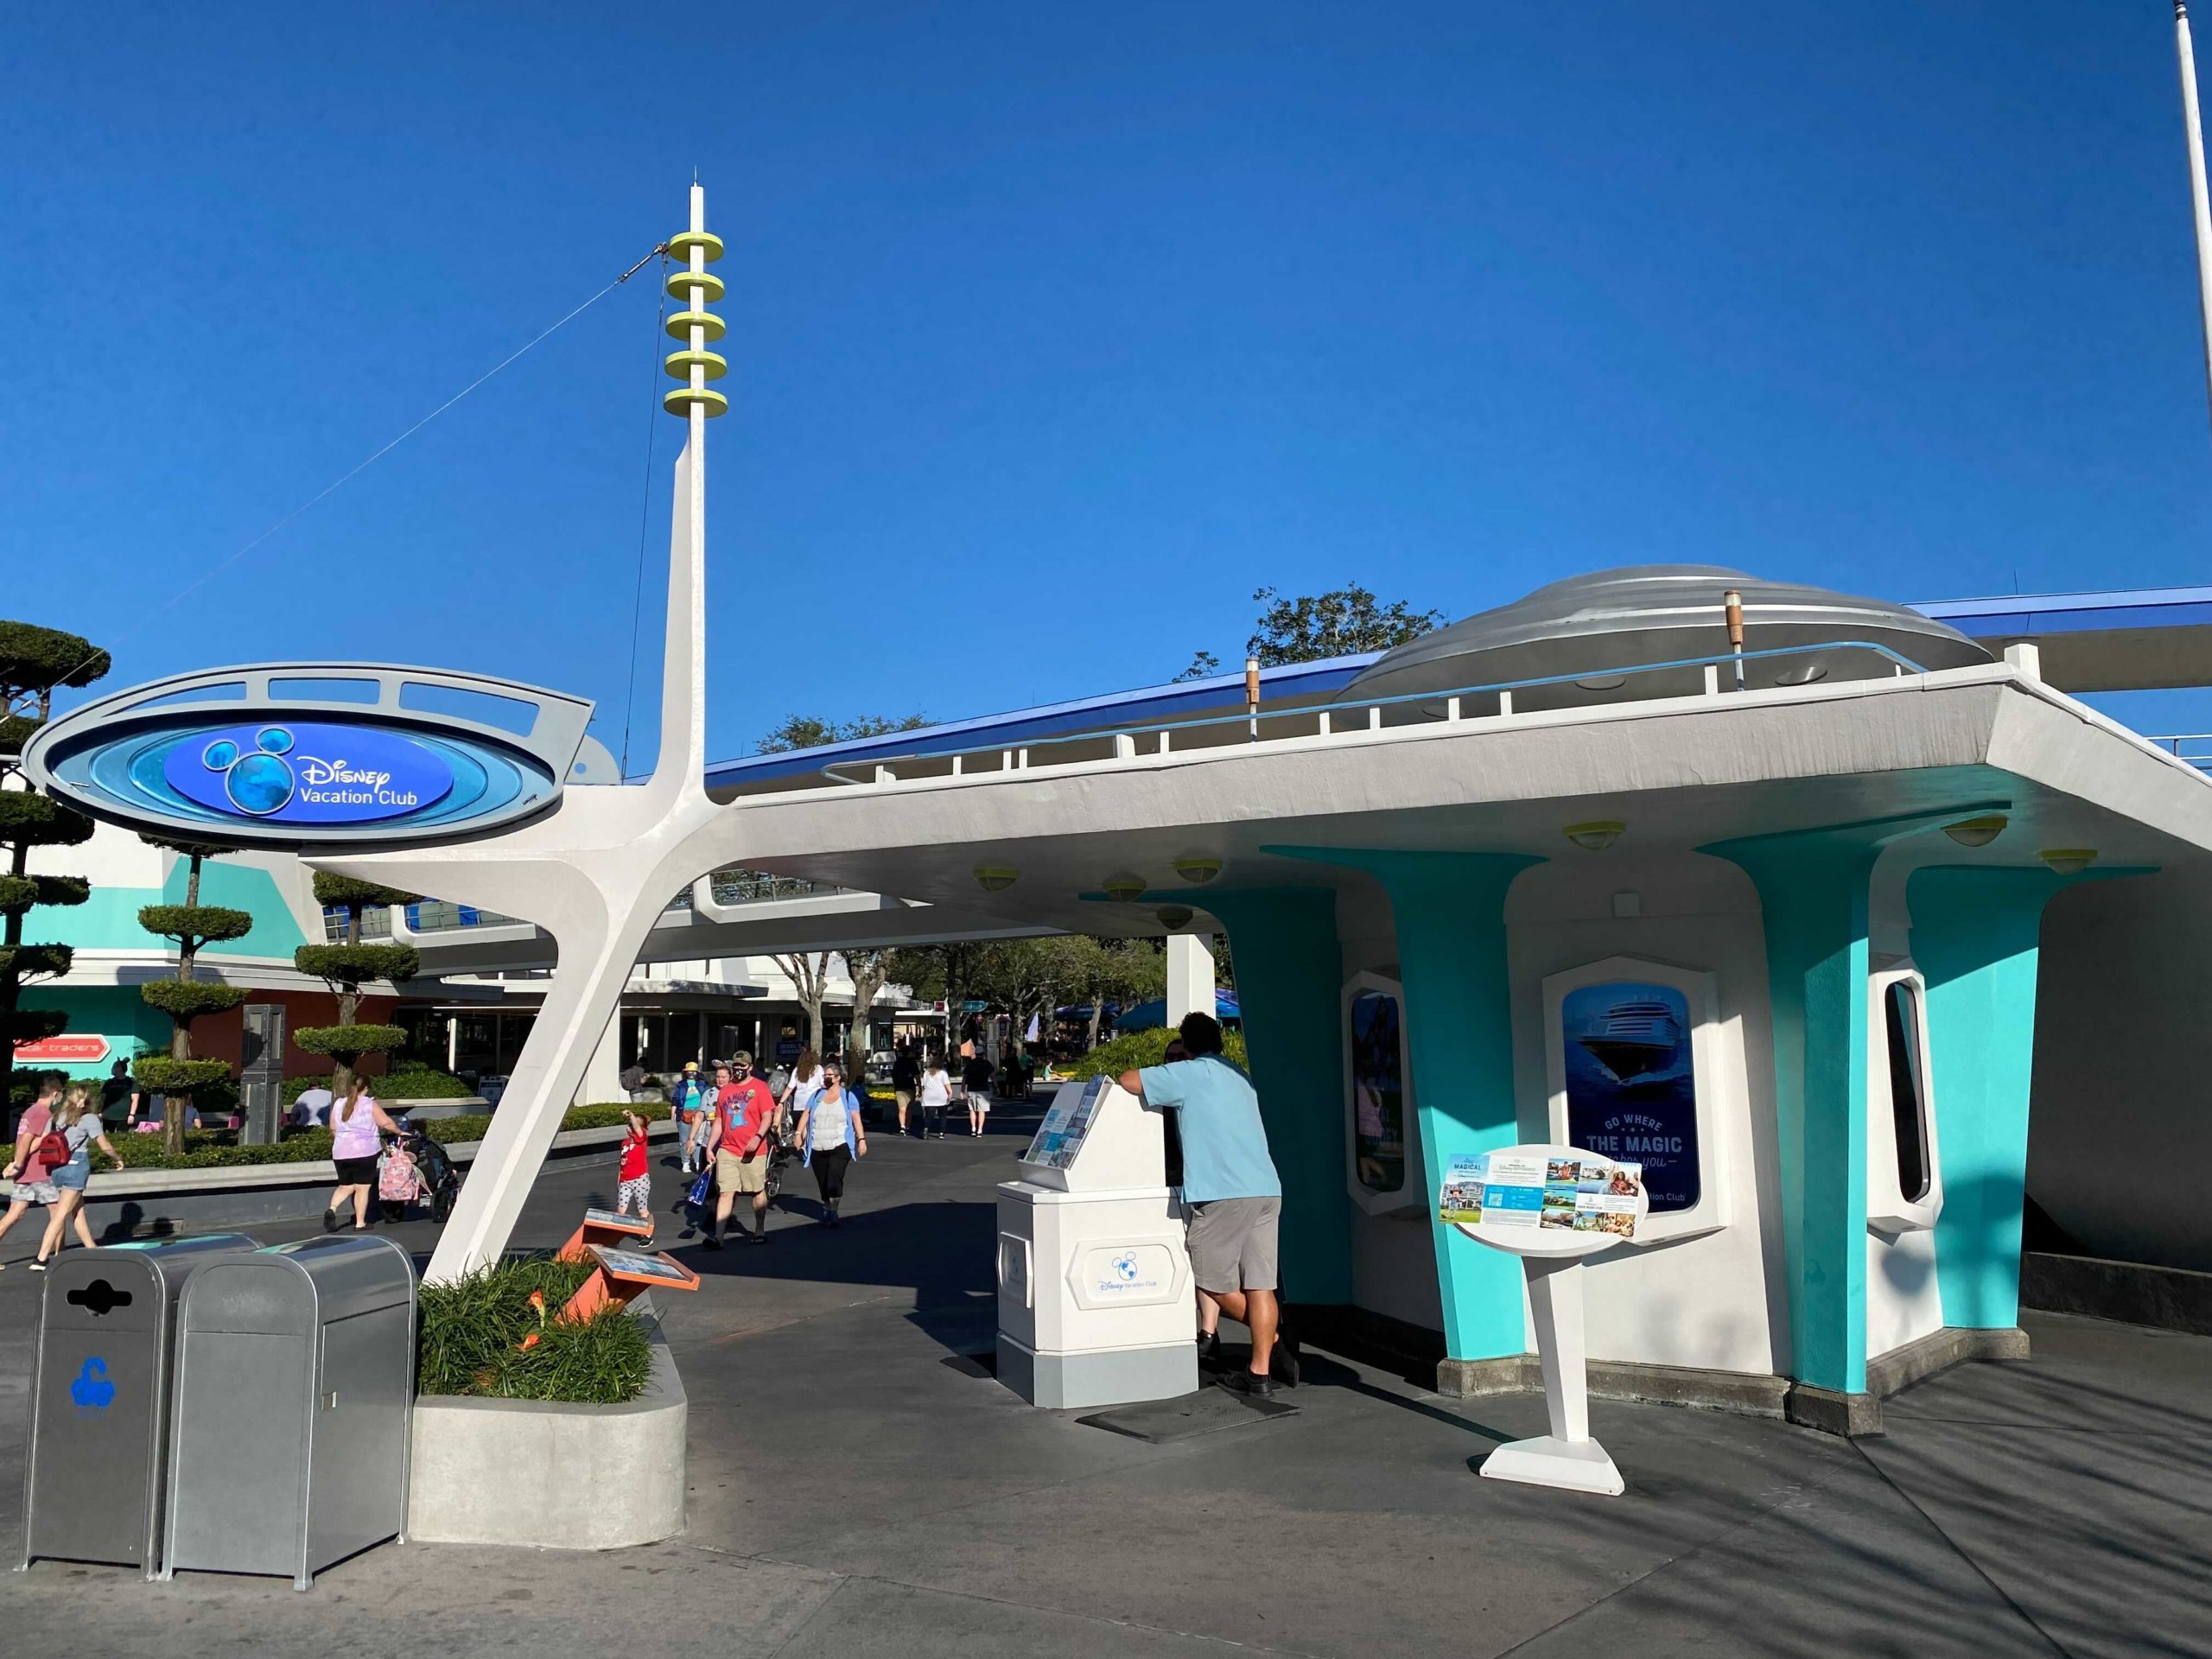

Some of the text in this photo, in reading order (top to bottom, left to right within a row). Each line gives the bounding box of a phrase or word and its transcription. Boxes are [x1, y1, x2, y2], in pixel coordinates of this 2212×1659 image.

[301, 788, 417, 804] Vacation Club
[1605, 1115, 1662, 1131] GO WHERE
[1586, 1136, 1682, 1153] THE MAGIC
[1643, 1157, 1667, 1170] you
